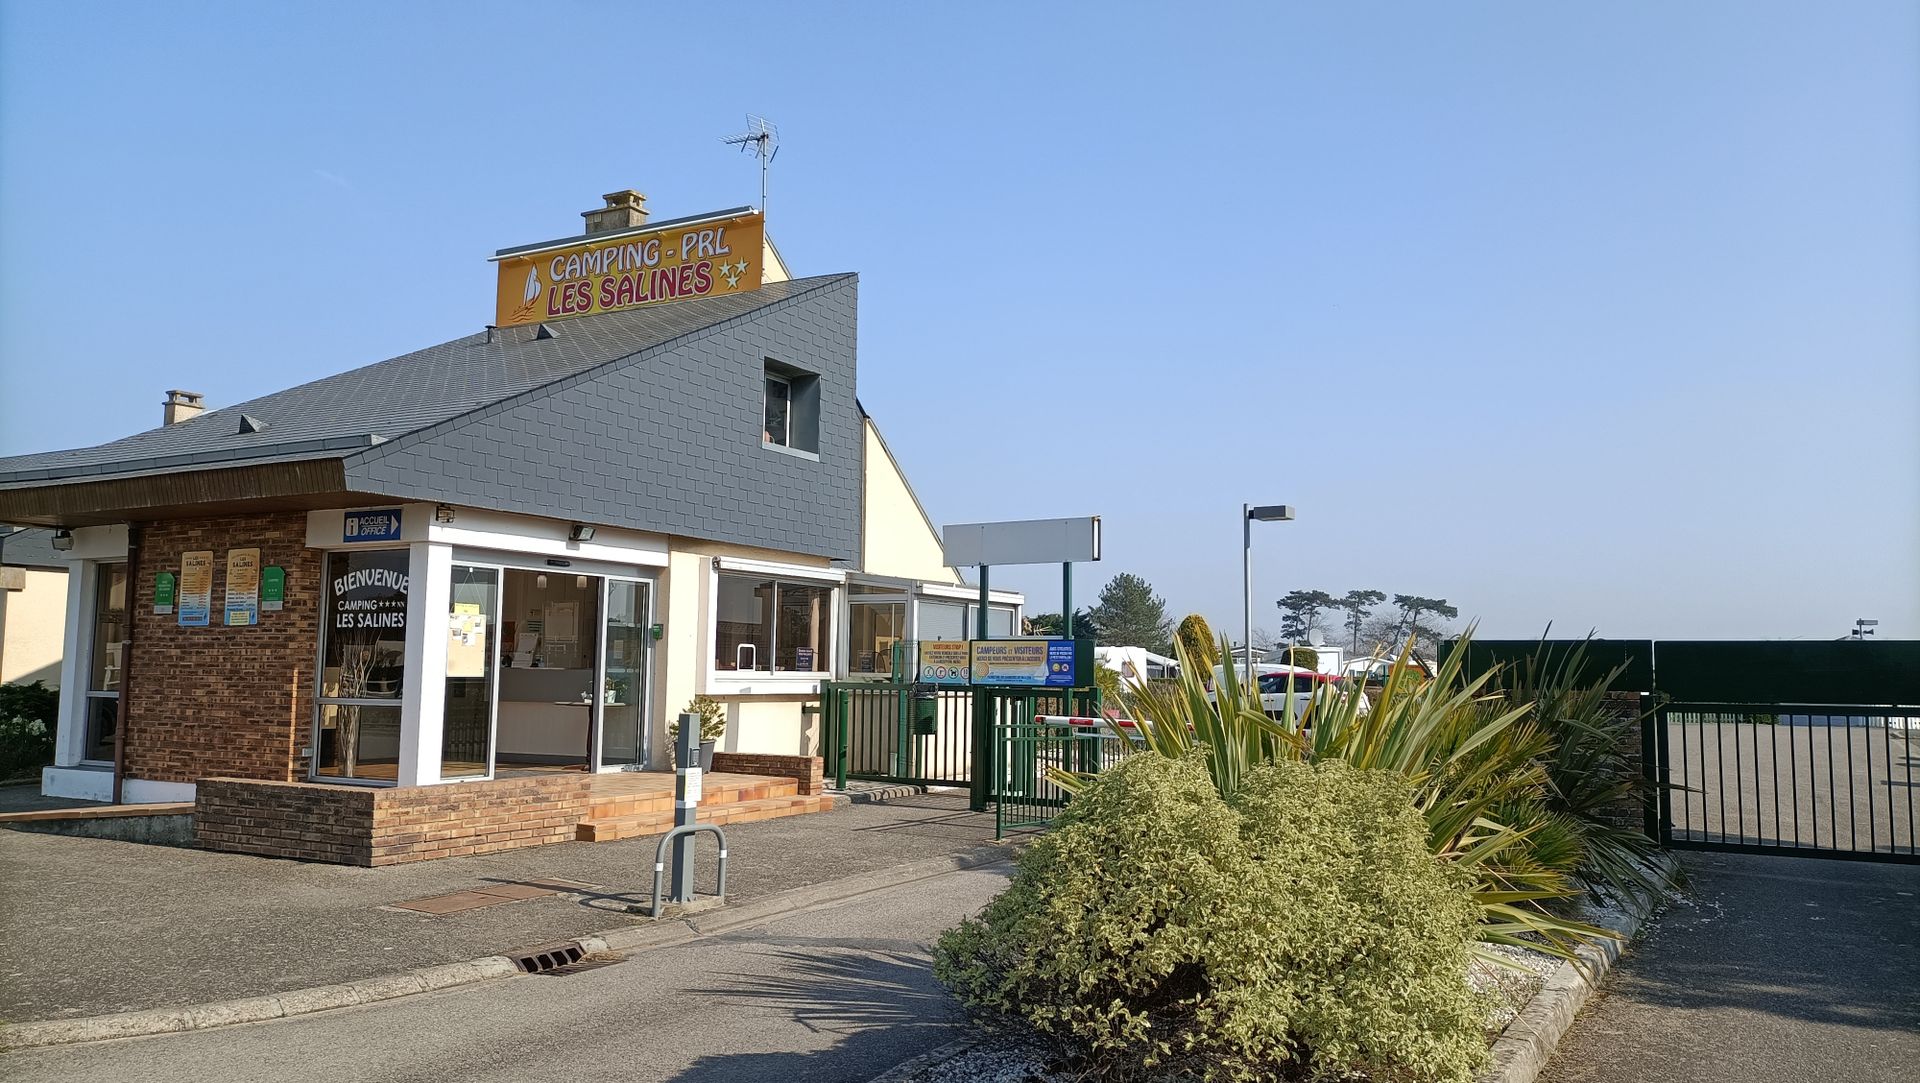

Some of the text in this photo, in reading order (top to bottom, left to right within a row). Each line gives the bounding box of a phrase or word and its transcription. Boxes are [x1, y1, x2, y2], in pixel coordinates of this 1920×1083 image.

[550, 238, 662, 282] CAMPING
[681, 226, 731, 261] PRL
[547, 260, 714, 317] LES SALINES
[360, 516, 389, 525] ACCUEIL
[361, 527, 386, 536] OFFICE
[334, 568, 409, 596] BIENVENUE
[338, 599, 377, 611] CAMPING
[336, 612, 405, 628] LES SALINES
[976, 646, 1007, 655] CAMPEURS
[1014, 646, 1044, 655] VISITEURS
